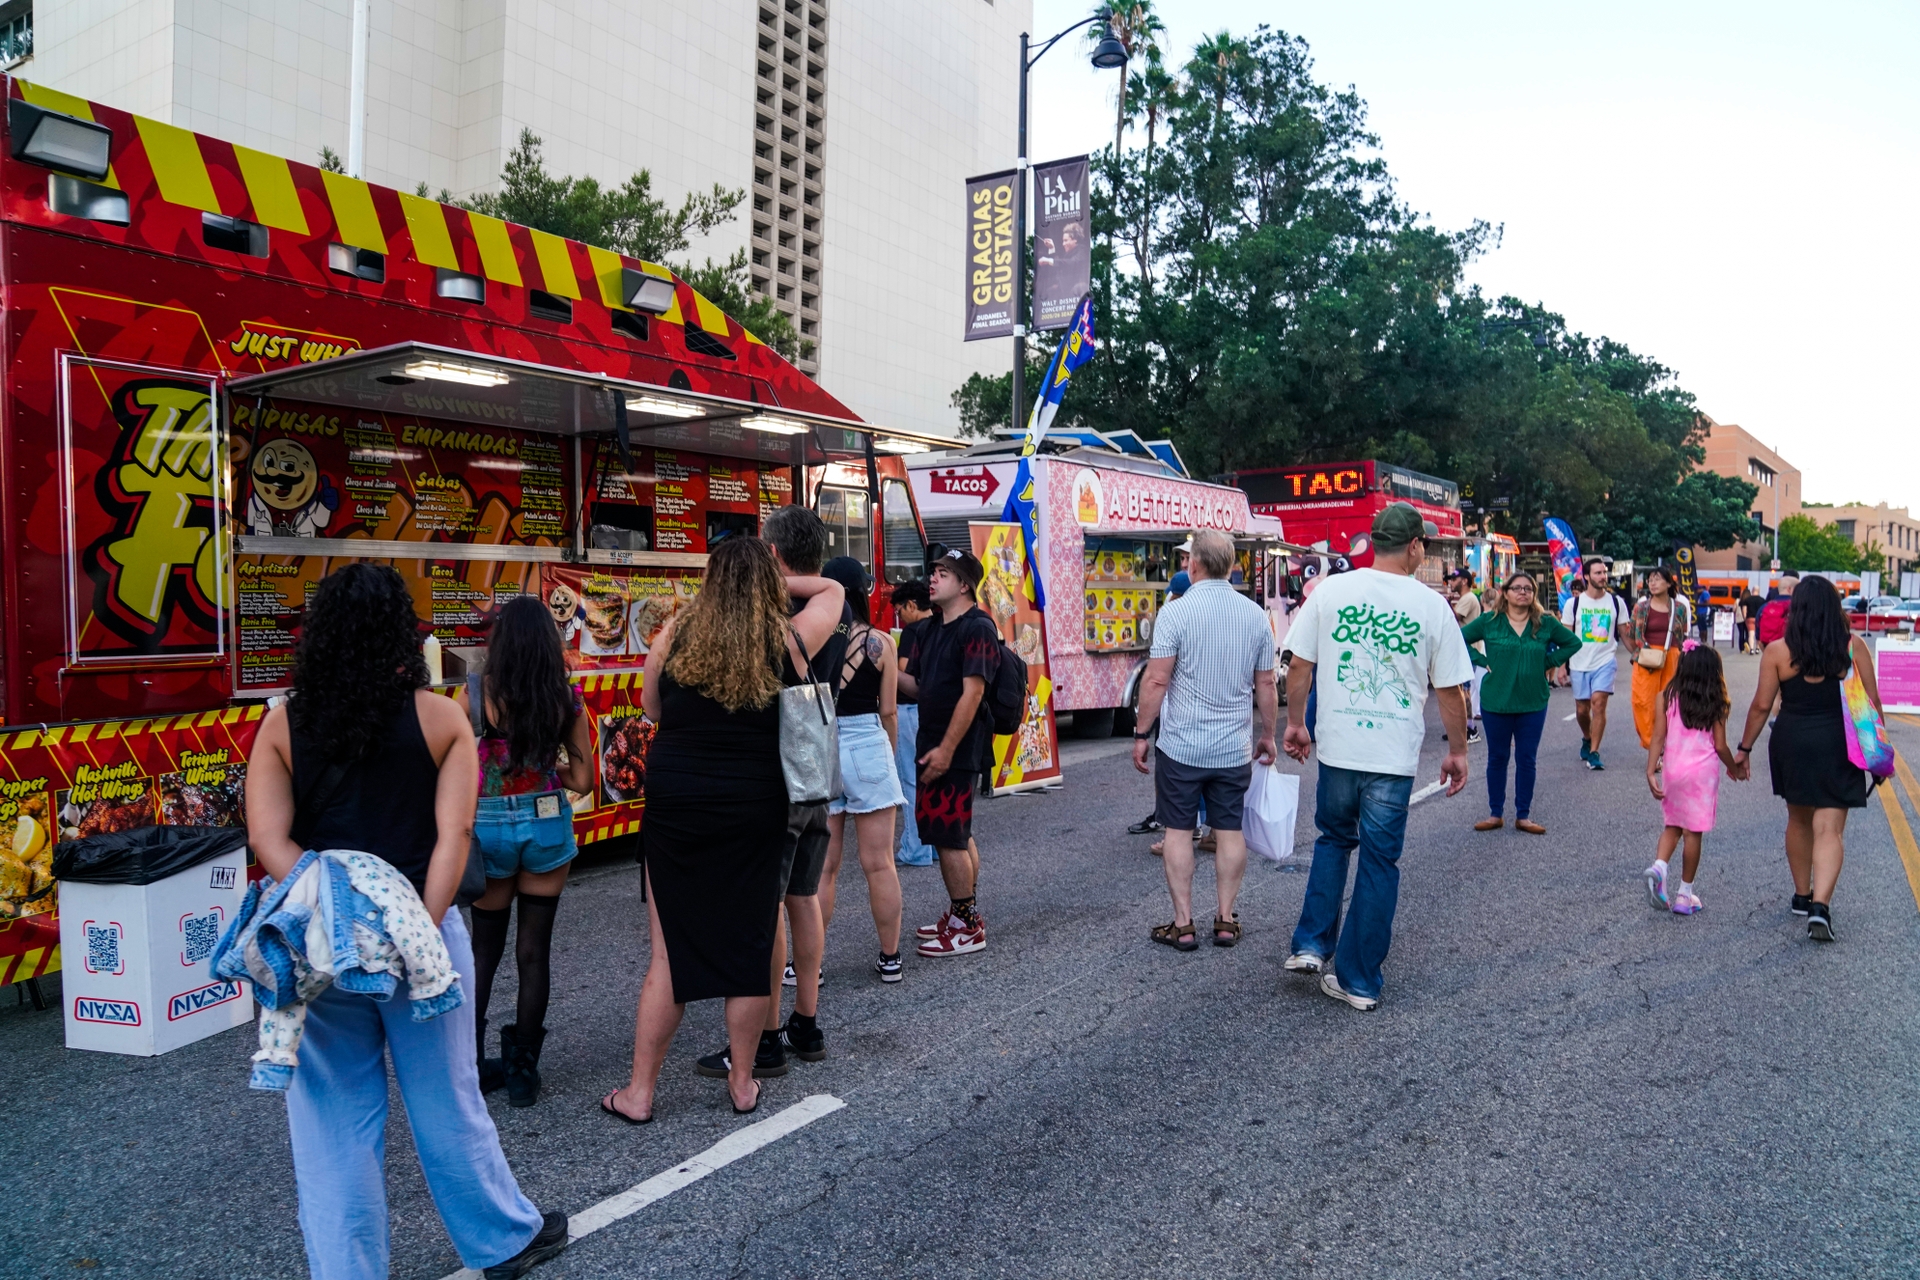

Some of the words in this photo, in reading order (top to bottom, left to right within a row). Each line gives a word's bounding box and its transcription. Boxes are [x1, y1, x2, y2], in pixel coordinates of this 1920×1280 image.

[1044, 174, 1067, 196] LA
[1044, 190, 1081, 215] Phil
[972, 188, 992, 306] GRACIAS
[993, 185, 1012, 303] GUSTAVO
[1059, 297, 1080, 305] DISNEY
[1041, 305, 1066, 313] CONCERT
[972, 321, 988, 329] FINAL
[989, 318, 1010, 327] SEASON
[230, 330, 299, 360] JUST
[232, 404, 340, 435] PUPUSAS
[402, 425, 517, 455] EMPANADAS
[344, 476, 362, 488] Cheese
[363, 480, 374, 488] and
[416, 472, 460, 490] Salsas
[944, 479, 988, 492] TACOS
[1284, 470, 1363, 496] TAC
[356, 504, 373, 514] Cheese
[374, 505, 387, 517] Only
[1109, 486, 1123, 520] A
[1128, 488, 1192, 527] BETTER
[1194, 498, 1234, 532] TACO
[238, 561, 298, 575] Appetizers
[431, 566, 454, 577] Tacos
[593, 572, 612, 582] Birria
[632, 573, 657, 584] Pupusas
[239, 581, 259, 589] Asada
[260, 581, 275, 590] Fries
[628, 583, 644, 597] Frijol
[657, 584, 674, 595] Queso
[240, 617, 260, 626] Birria
[261, 617, 276, 626] Fries
[262, 654, 282, 662] Cheese
[611, 705, 626, 719] BBQ
[626, 704, 643, 719] Wings
[180, 748, 229, 770] Teriyaki
[75, 760, 138, 785] Nashville
[185, 767, 226, 787] Wings
[71, 783, 99, 805] Hot
[101, 779, 145, 801] Wings
